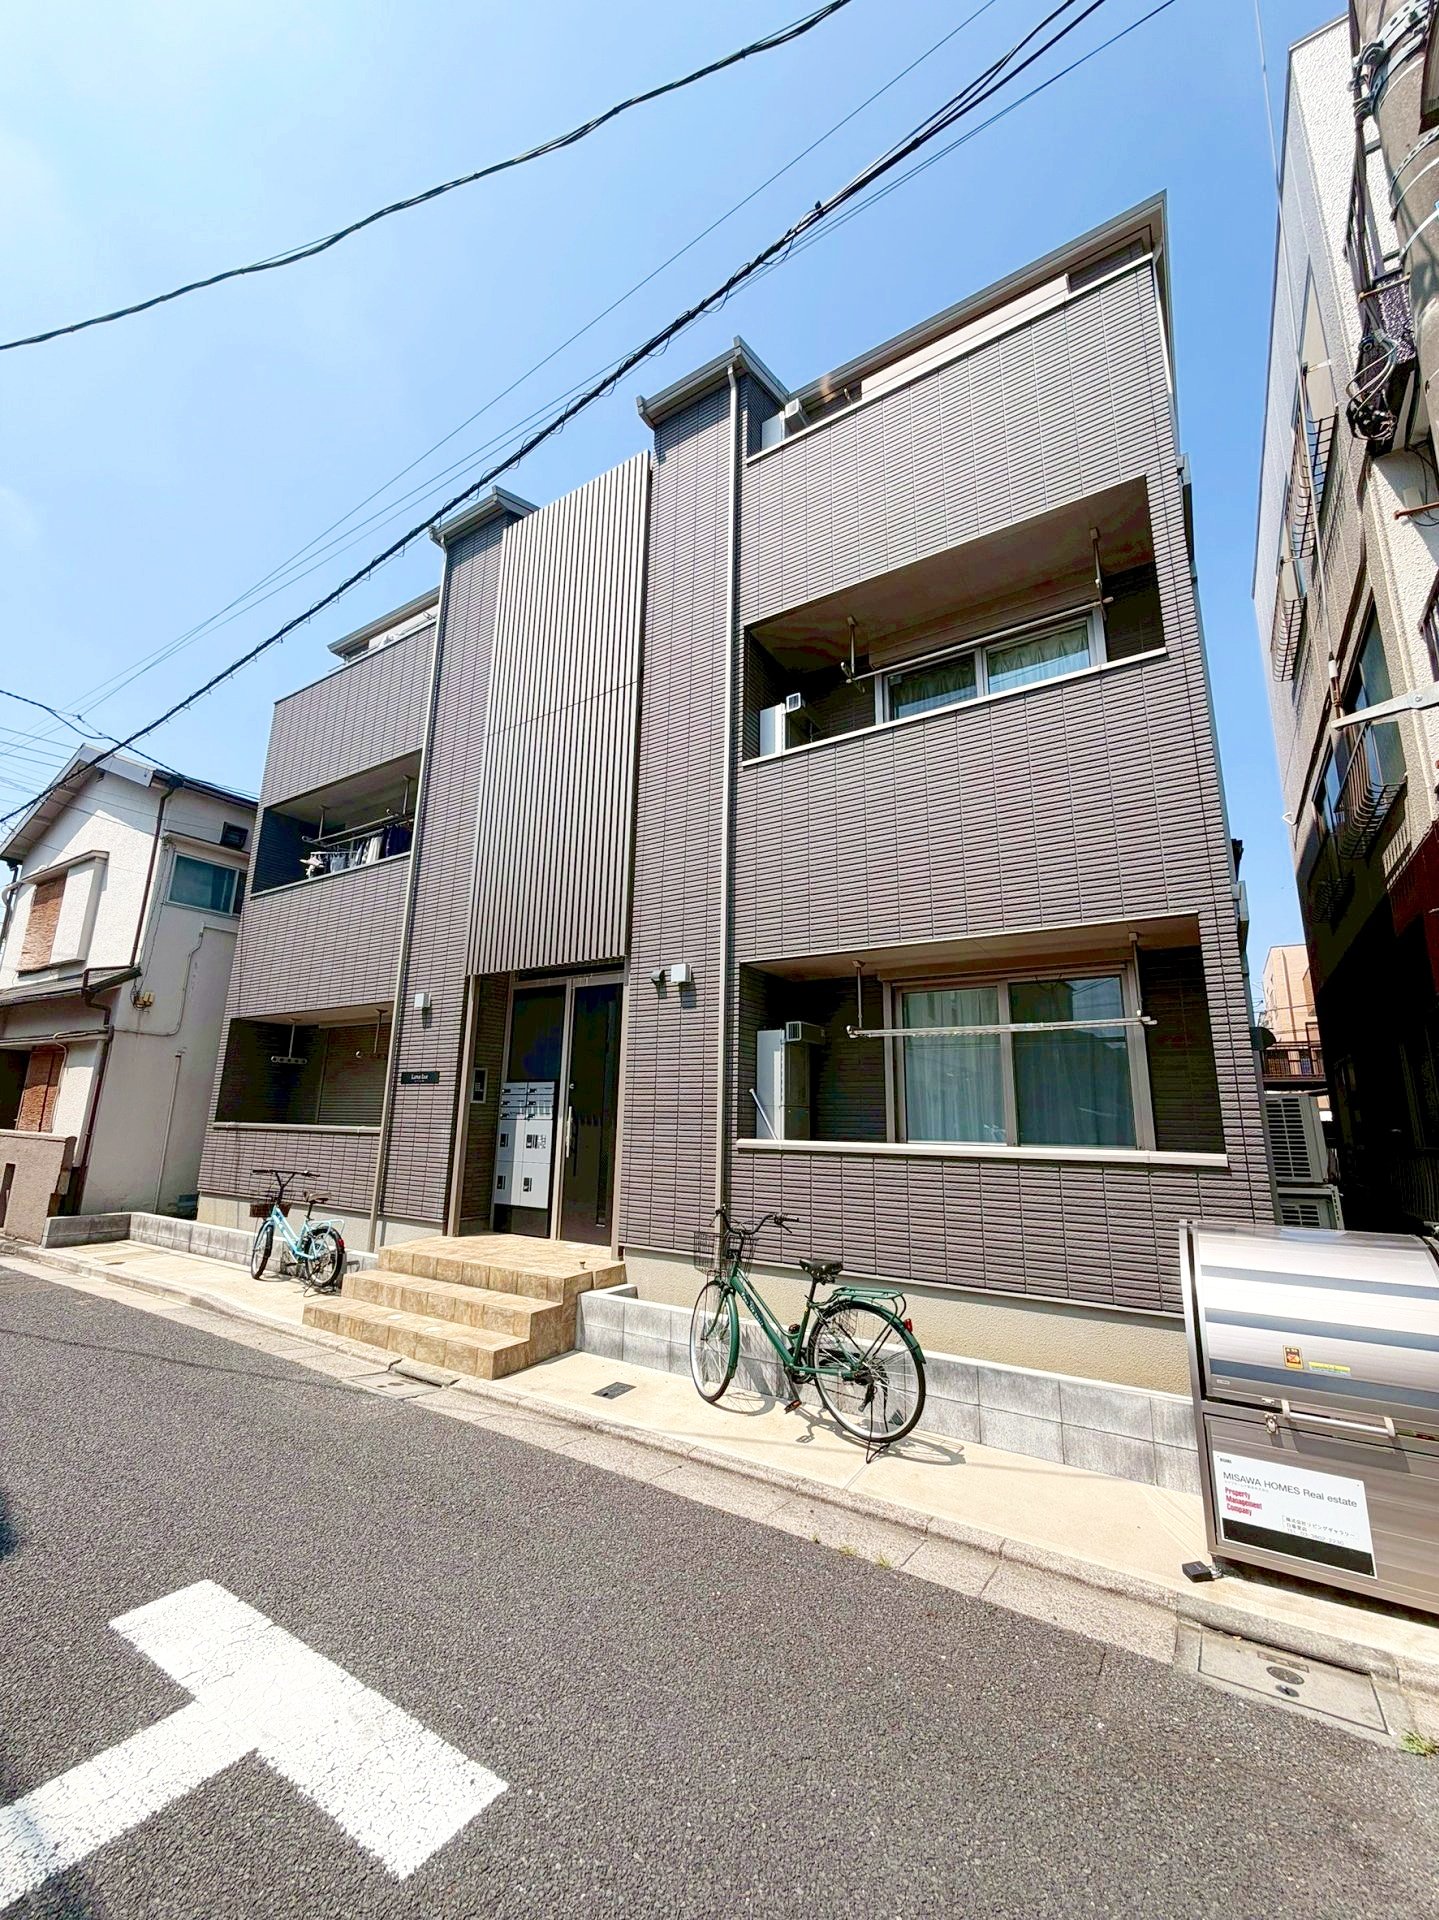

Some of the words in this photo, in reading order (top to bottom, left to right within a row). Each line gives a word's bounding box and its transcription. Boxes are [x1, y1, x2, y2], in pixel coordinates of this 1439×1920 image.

[1223, 1471, 1262, 1487] MISAWA
[1264, 1480, 1301, 1495] HOMES
[1303, 1488, 1325, 1500] Real
[1327, 1494, 1358, 1508] estate
[1225, 1486, 1250, 1500] Property
[1226, 1495, 1262, 1510] Management
[1227, 1503, 1252, 1516] Company
